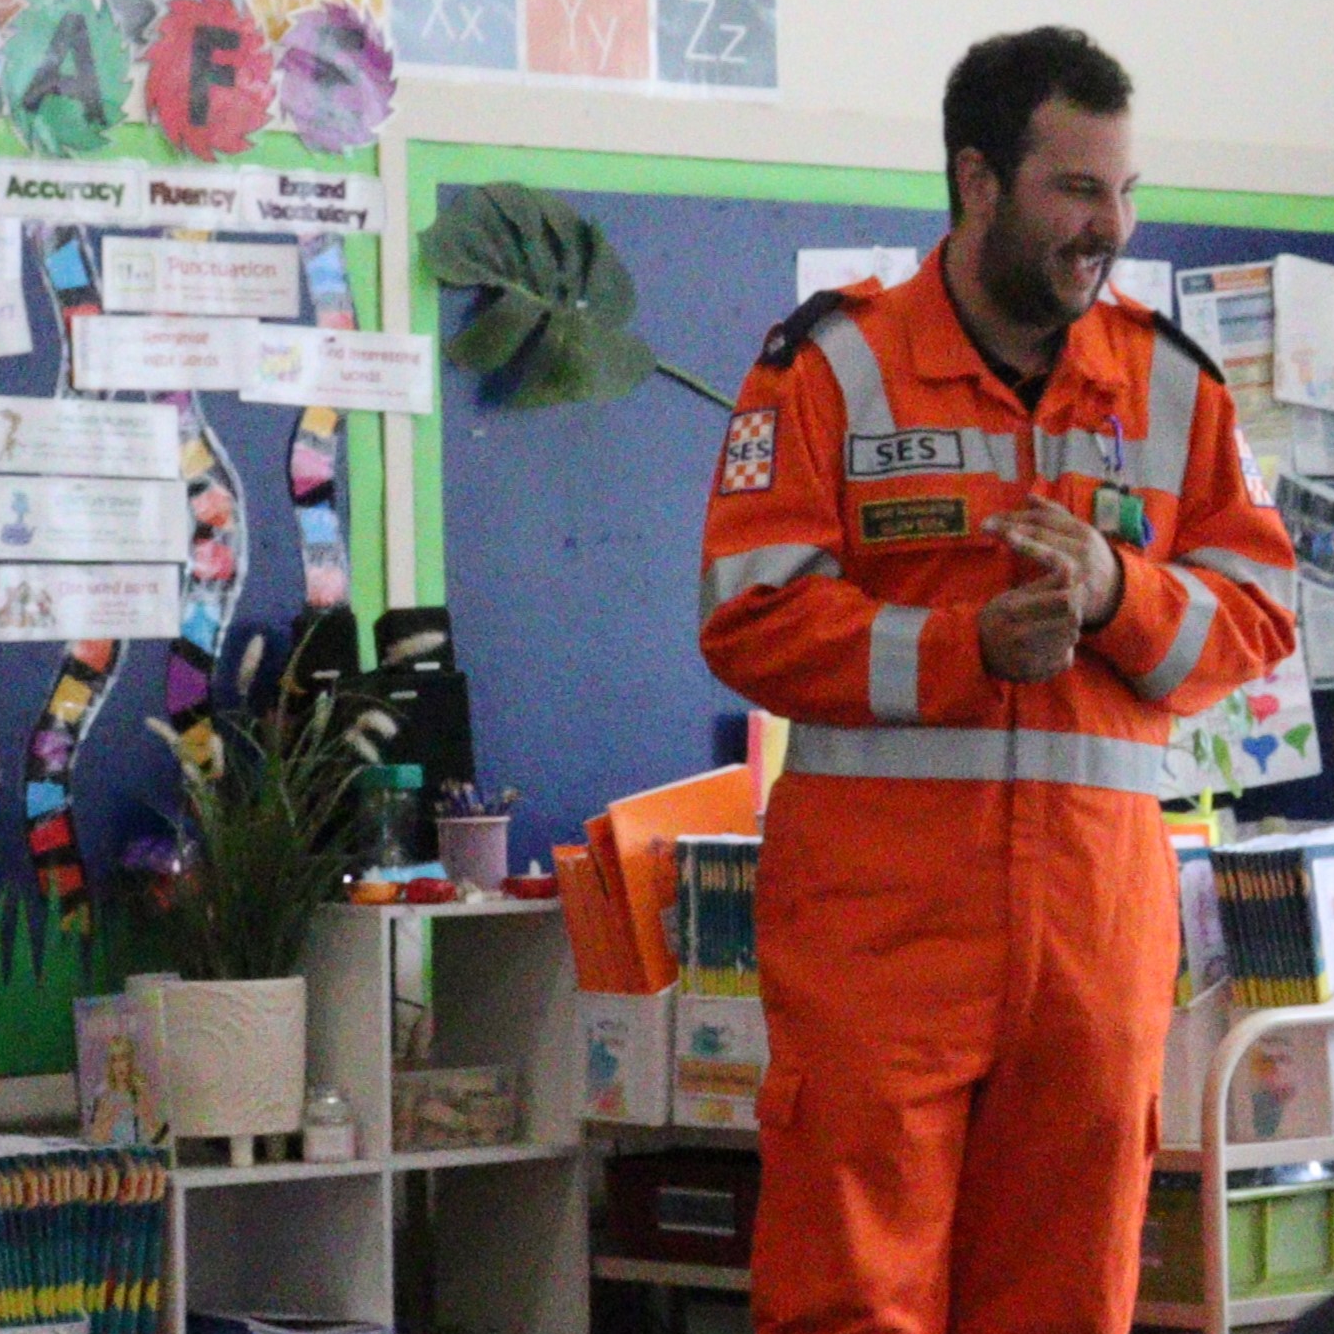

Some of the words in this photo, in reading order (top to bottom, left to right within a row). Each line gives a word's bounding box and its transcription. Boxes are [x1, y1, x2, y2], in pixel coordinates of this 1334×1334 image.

[5, 175, 126, 207] Accuracy
[149, 180, 237, 214] Fluency
[278, 174, 346, 200] Expand
[256, 199, 368, 230] Vocabulary
[167, 254, 278, 281] Punctuation
[727, 439, 769, 464] SES
[875, 436, 938, 467] SES
